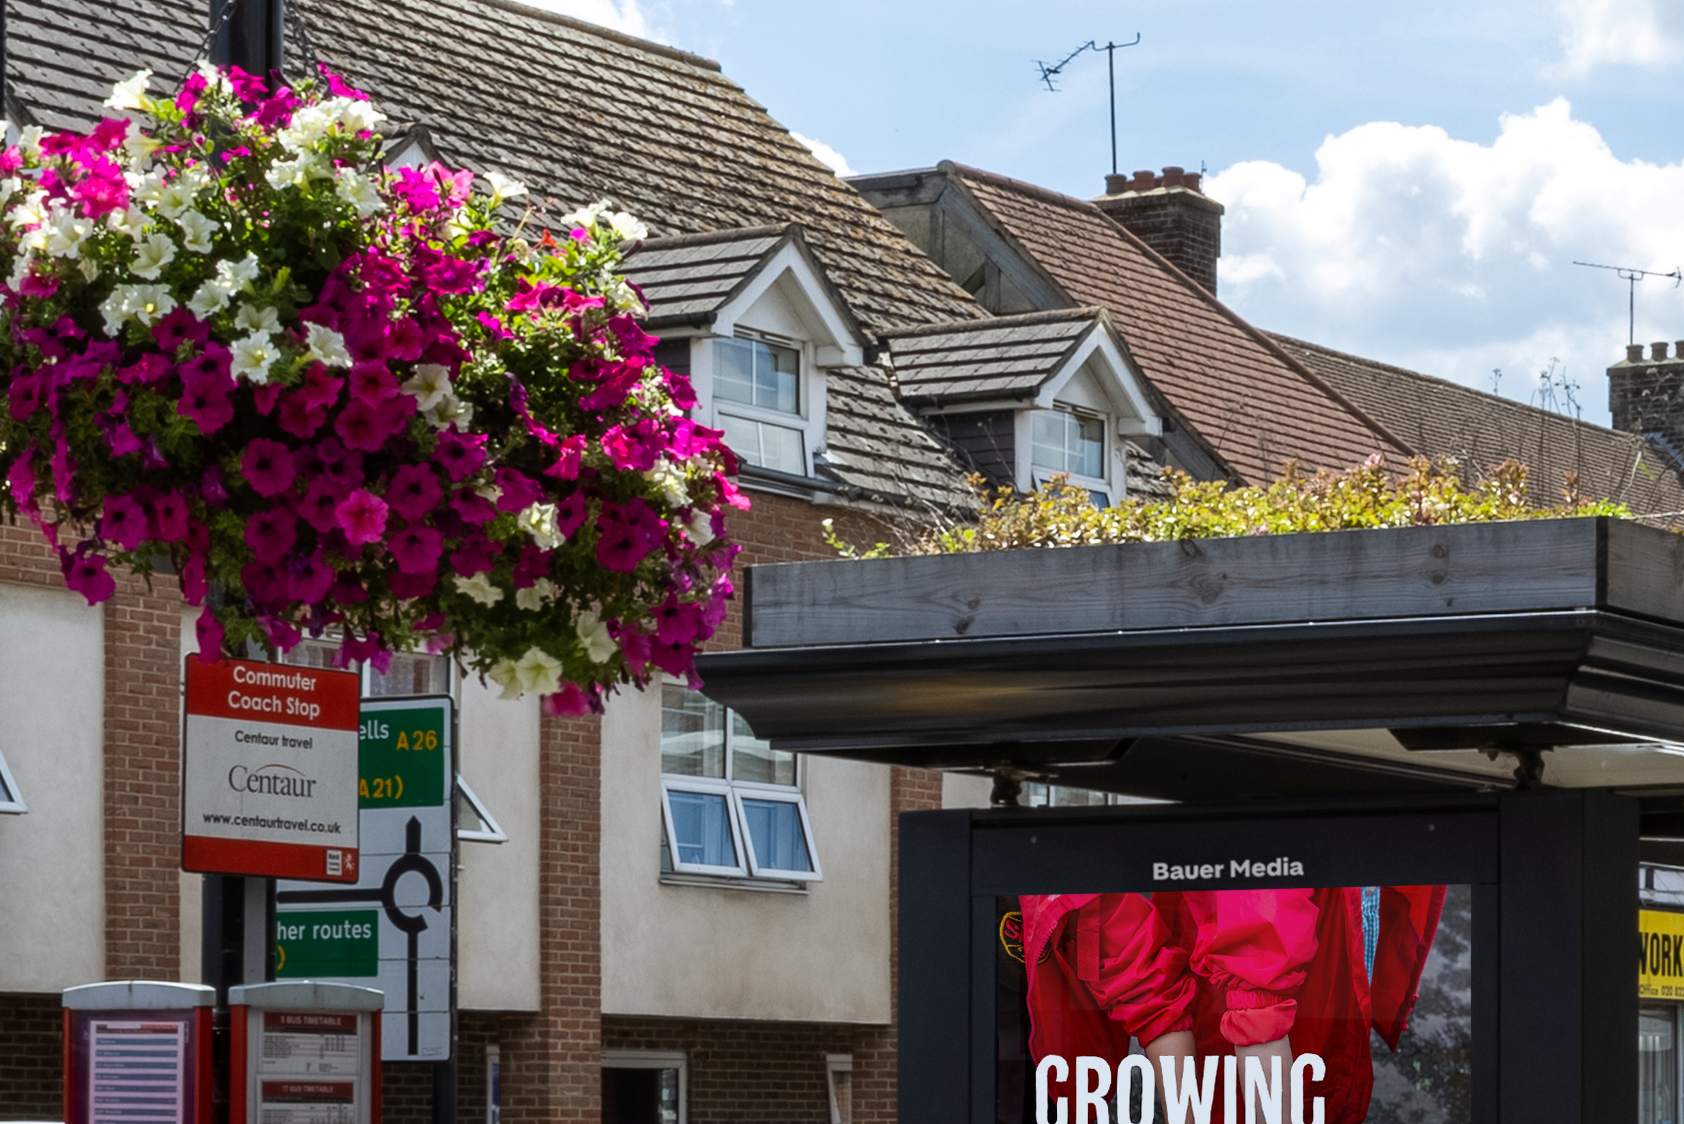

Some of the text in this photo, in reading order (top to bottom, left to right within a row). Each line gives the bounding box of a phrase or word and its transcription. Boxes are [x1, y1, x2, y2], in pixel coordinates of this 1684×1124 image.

[233, 665, 317, 691] Commuter
[228, 691, 320, 720] Coach Stop
[235, 730, 313, 749] Centaur travel
[229, 765, 317, 798] Centaur
[203, 812, 341, 834] www.centaurtravel.co.uk
[1153, 857, 1304, 881] Bauer Media
[313, 920, 372, 940] routes
